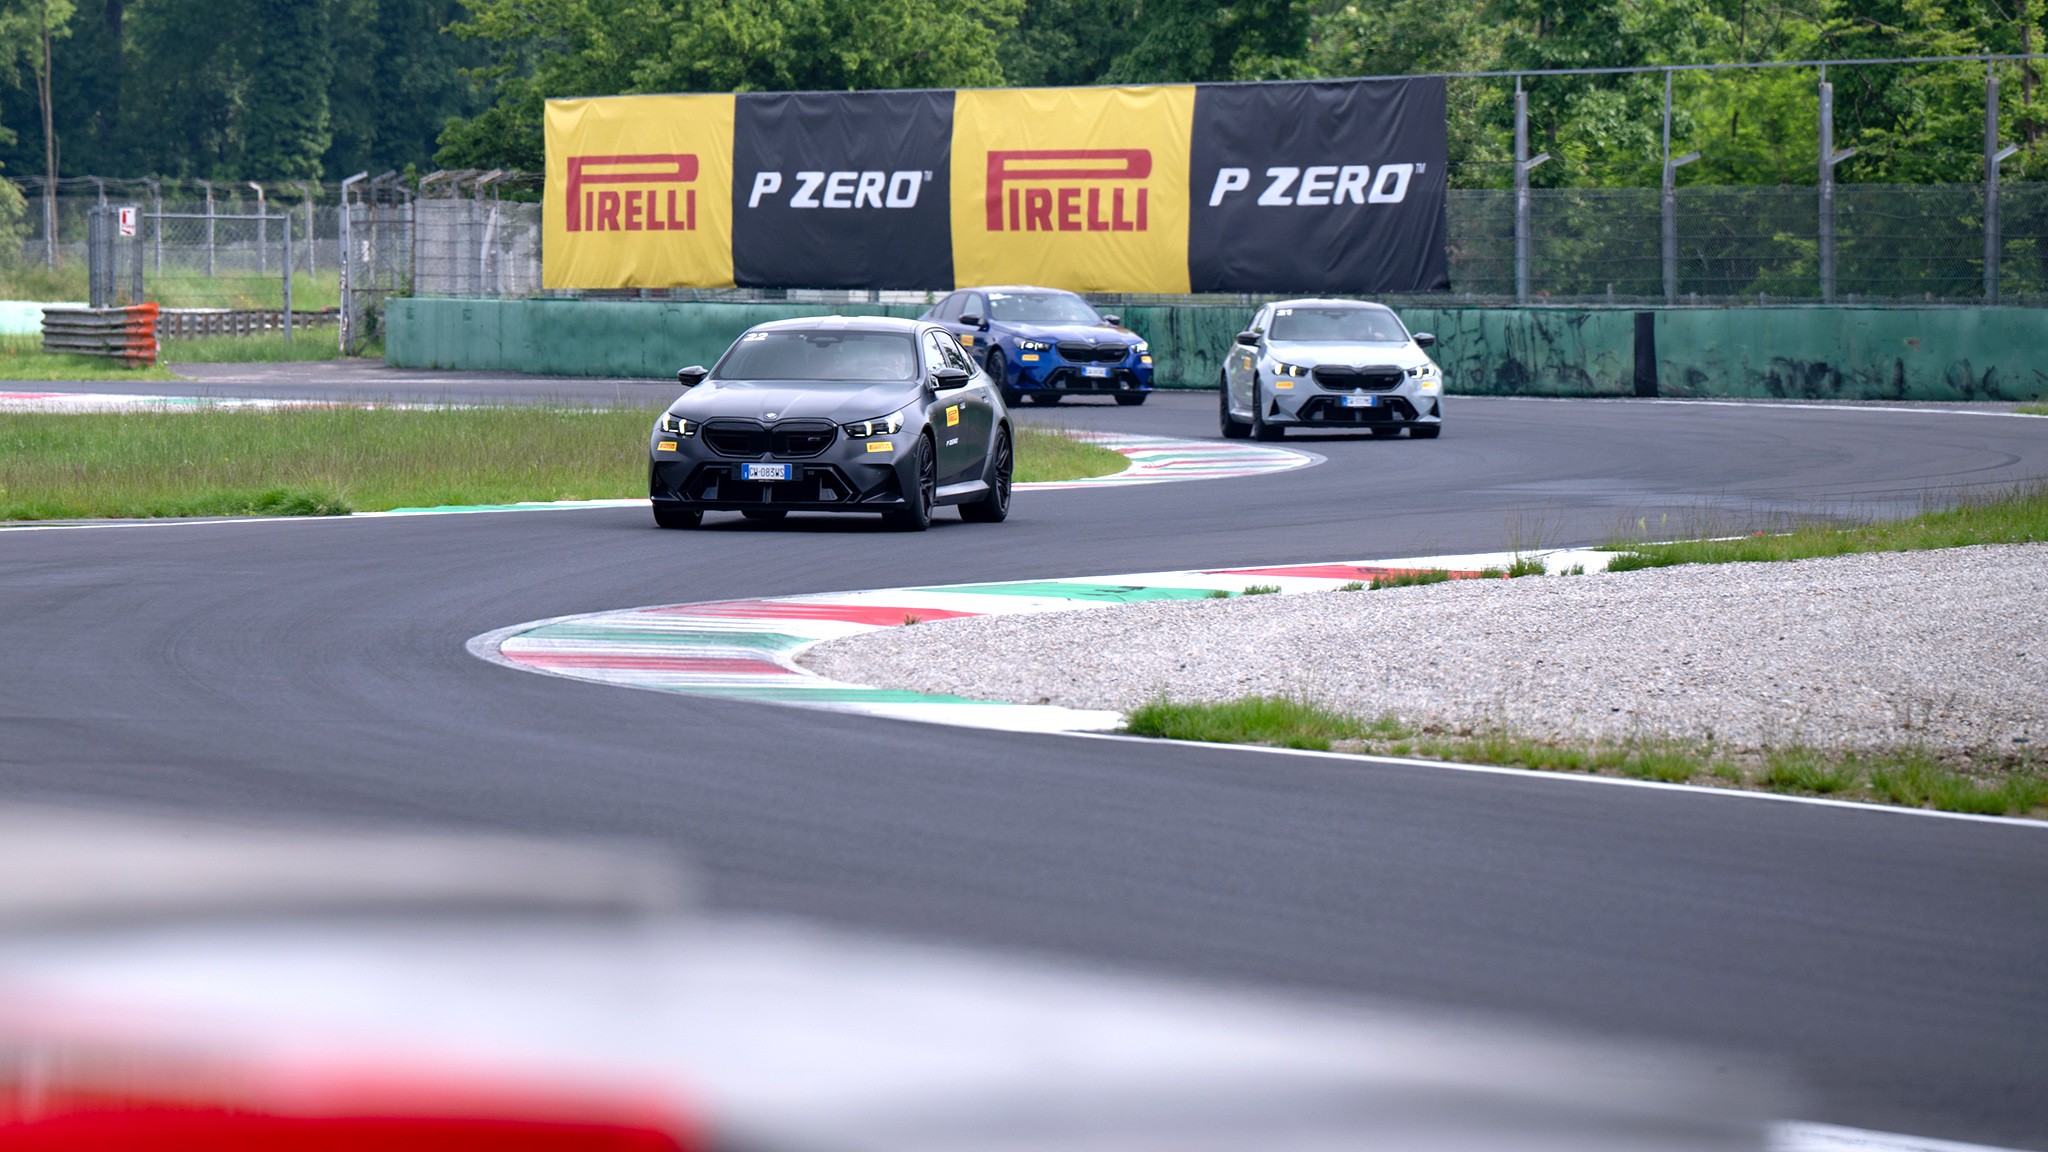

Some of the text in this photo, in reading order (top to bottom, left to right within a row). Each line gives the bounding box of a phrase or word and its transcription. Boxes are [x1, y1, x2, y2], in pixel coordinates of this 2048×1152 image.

[566, 153, 699, 232] PIRELLI
[748, 170, 923, 209] P ZERO
[986, 148, 1153, 232] PIRELLI
[1209, 167, 1250, 207] P
[1257, 163, 1415, 206] ZERO
